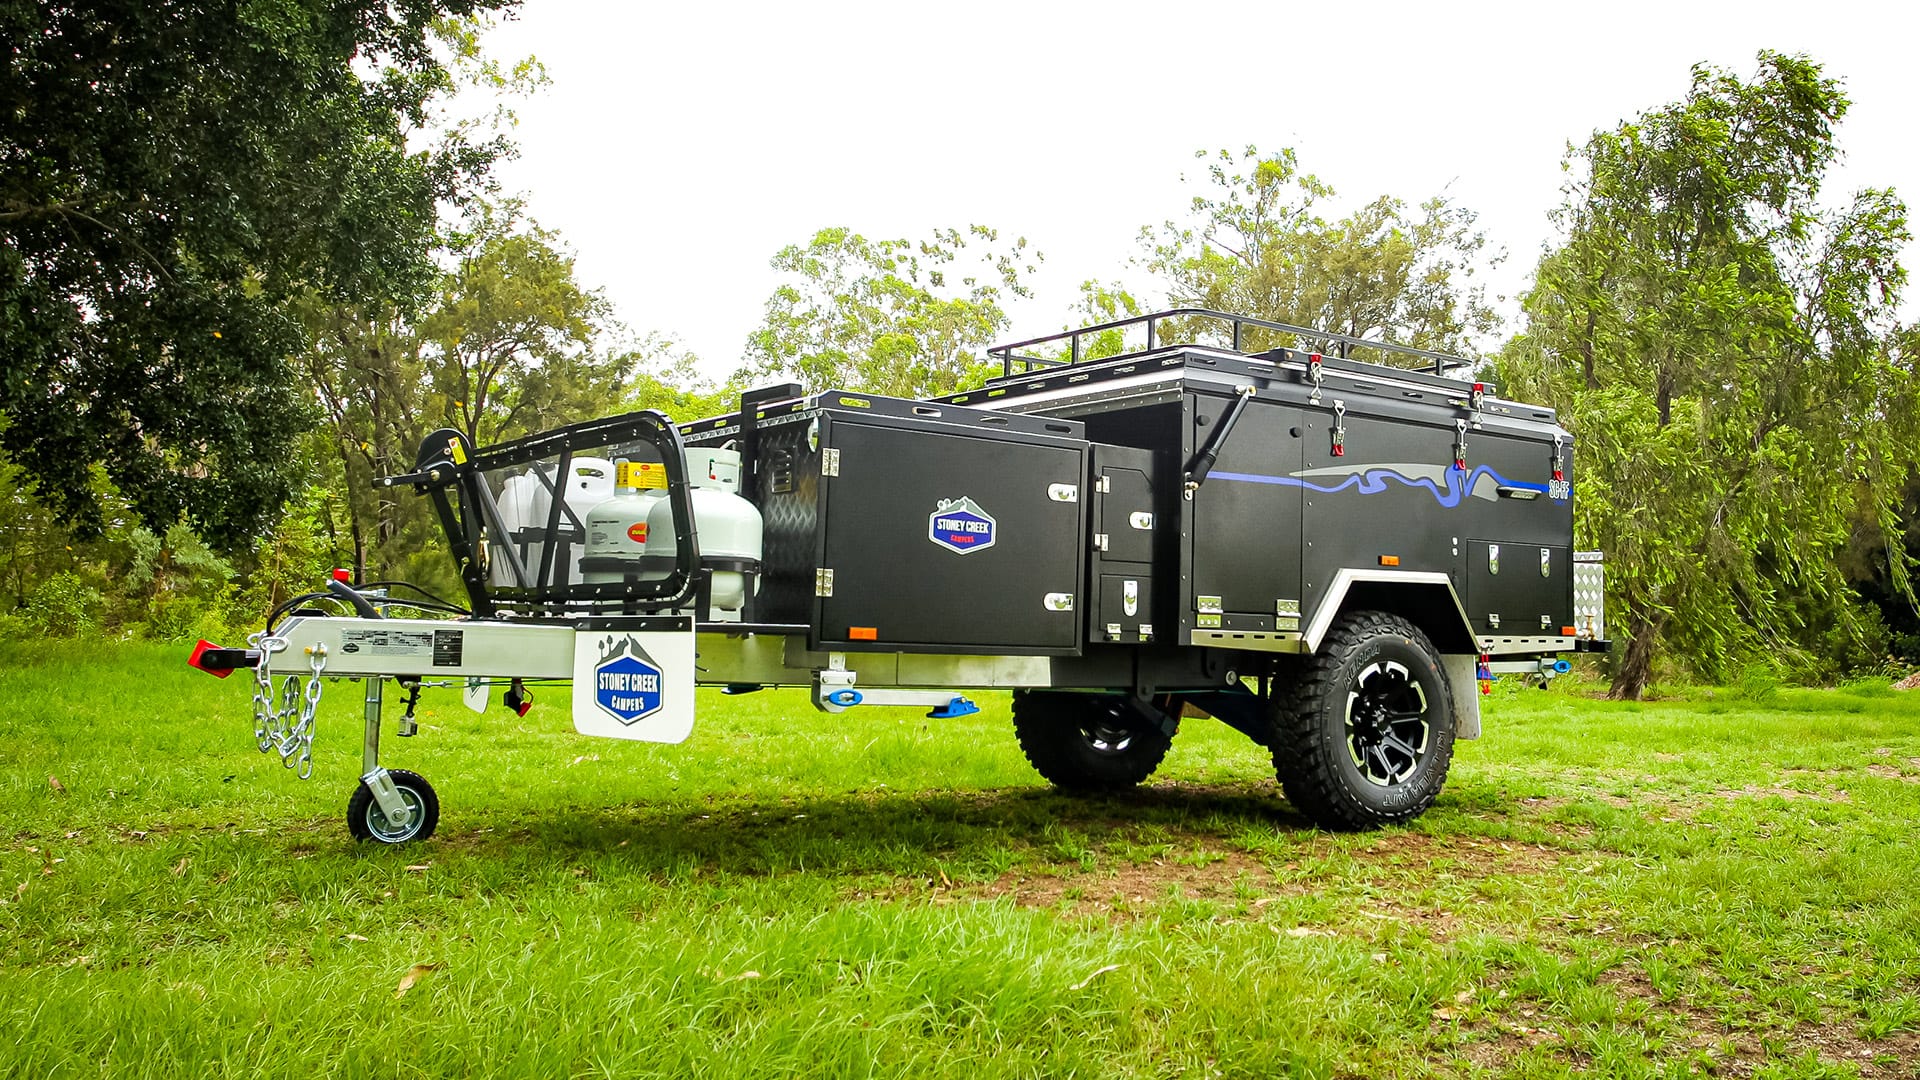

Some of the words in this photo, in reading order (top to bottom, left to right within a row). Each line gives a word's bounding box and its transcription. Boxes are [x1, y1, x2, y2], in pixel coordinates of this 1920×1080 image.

[937, 518, 966, 532] STONEY
[966, 520, 990, 534] CREEK
[599, 672, 631, 691] STONEY
[631, 674, 658, 693] CREEK
[611, 695, 644, 712] CAMPERS
